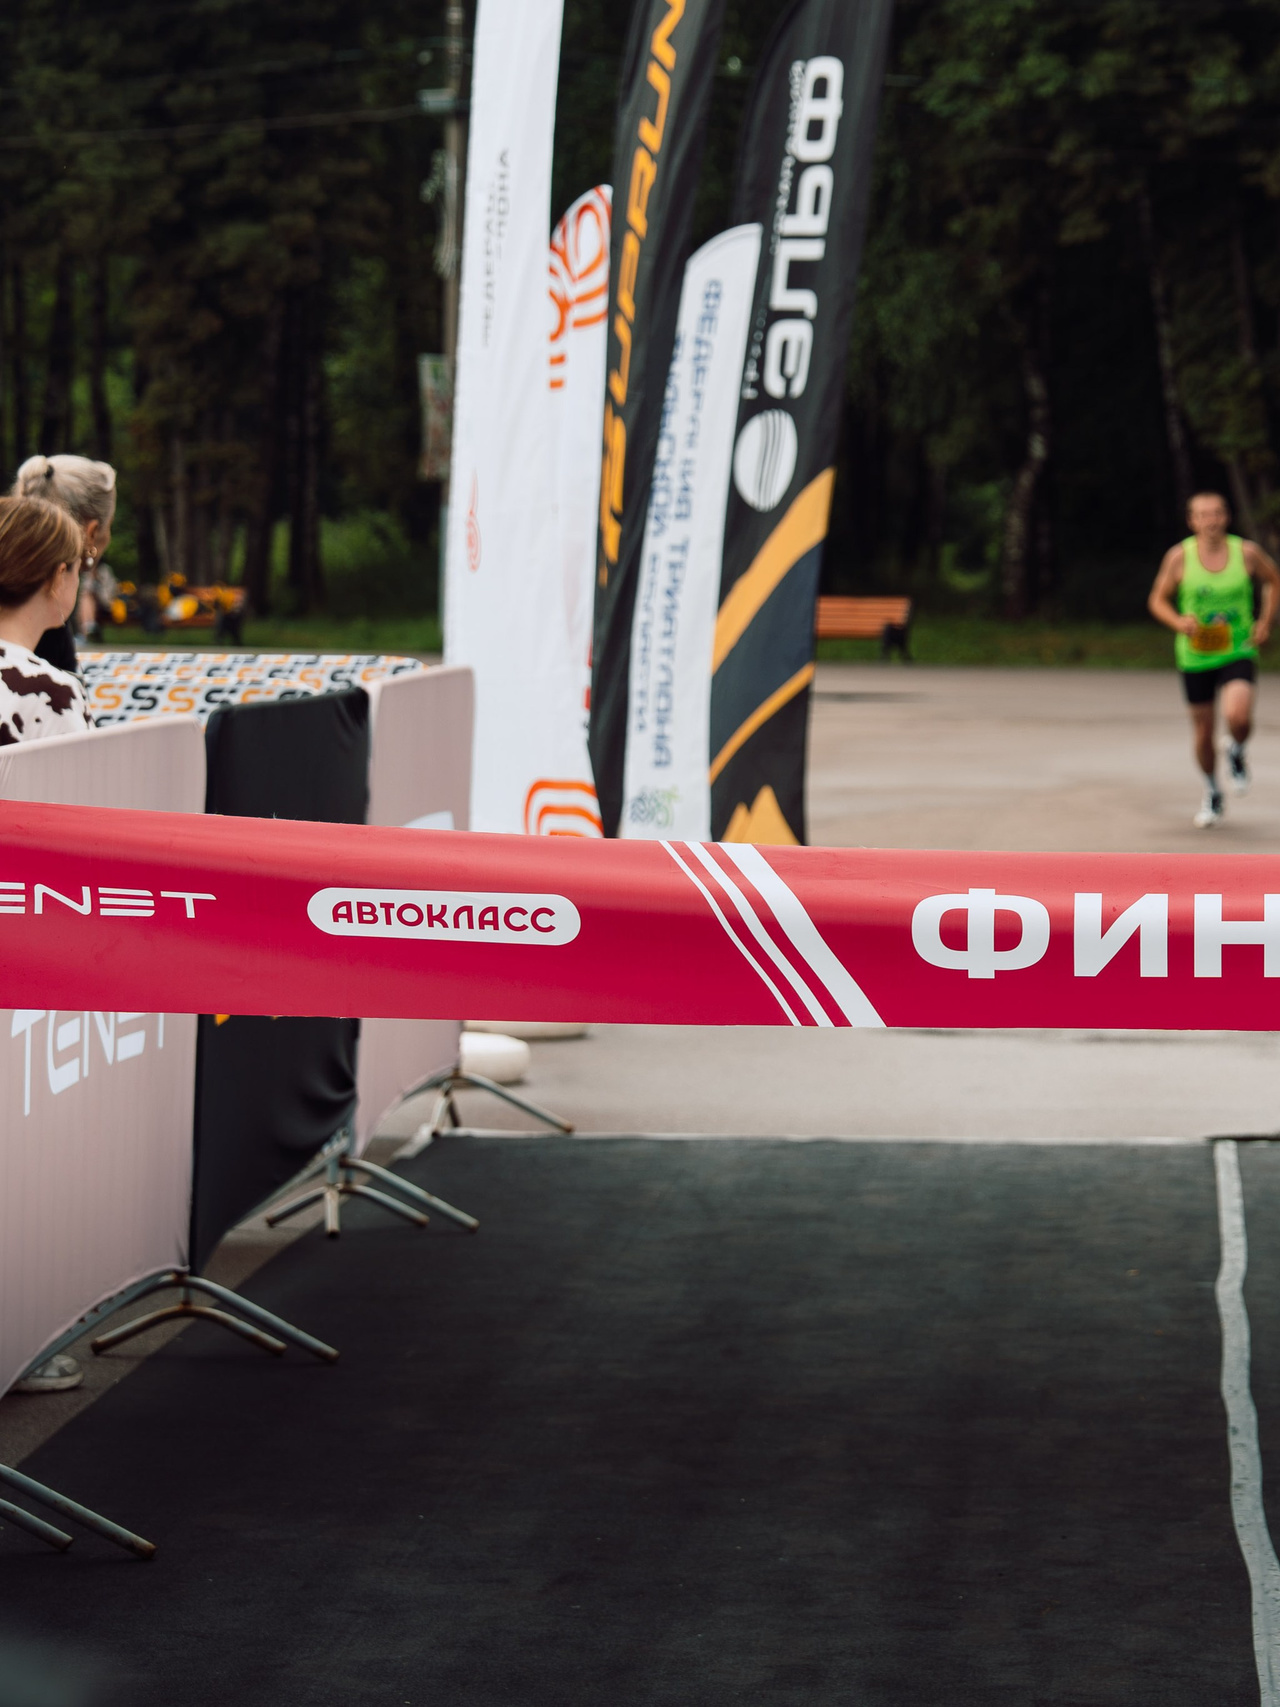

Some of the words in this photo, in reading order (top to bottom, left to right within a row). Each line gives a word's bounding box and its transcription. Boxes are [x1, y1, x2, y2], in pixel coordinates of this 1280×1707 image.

[764, 56, 844, 399] ЭЛЬФ
[651, 537, 692, 770] ТРИАТЛОНА
[0, 881, 217, 919] ENET
[331, 900, 557, 934] АВТОКЛАСС
